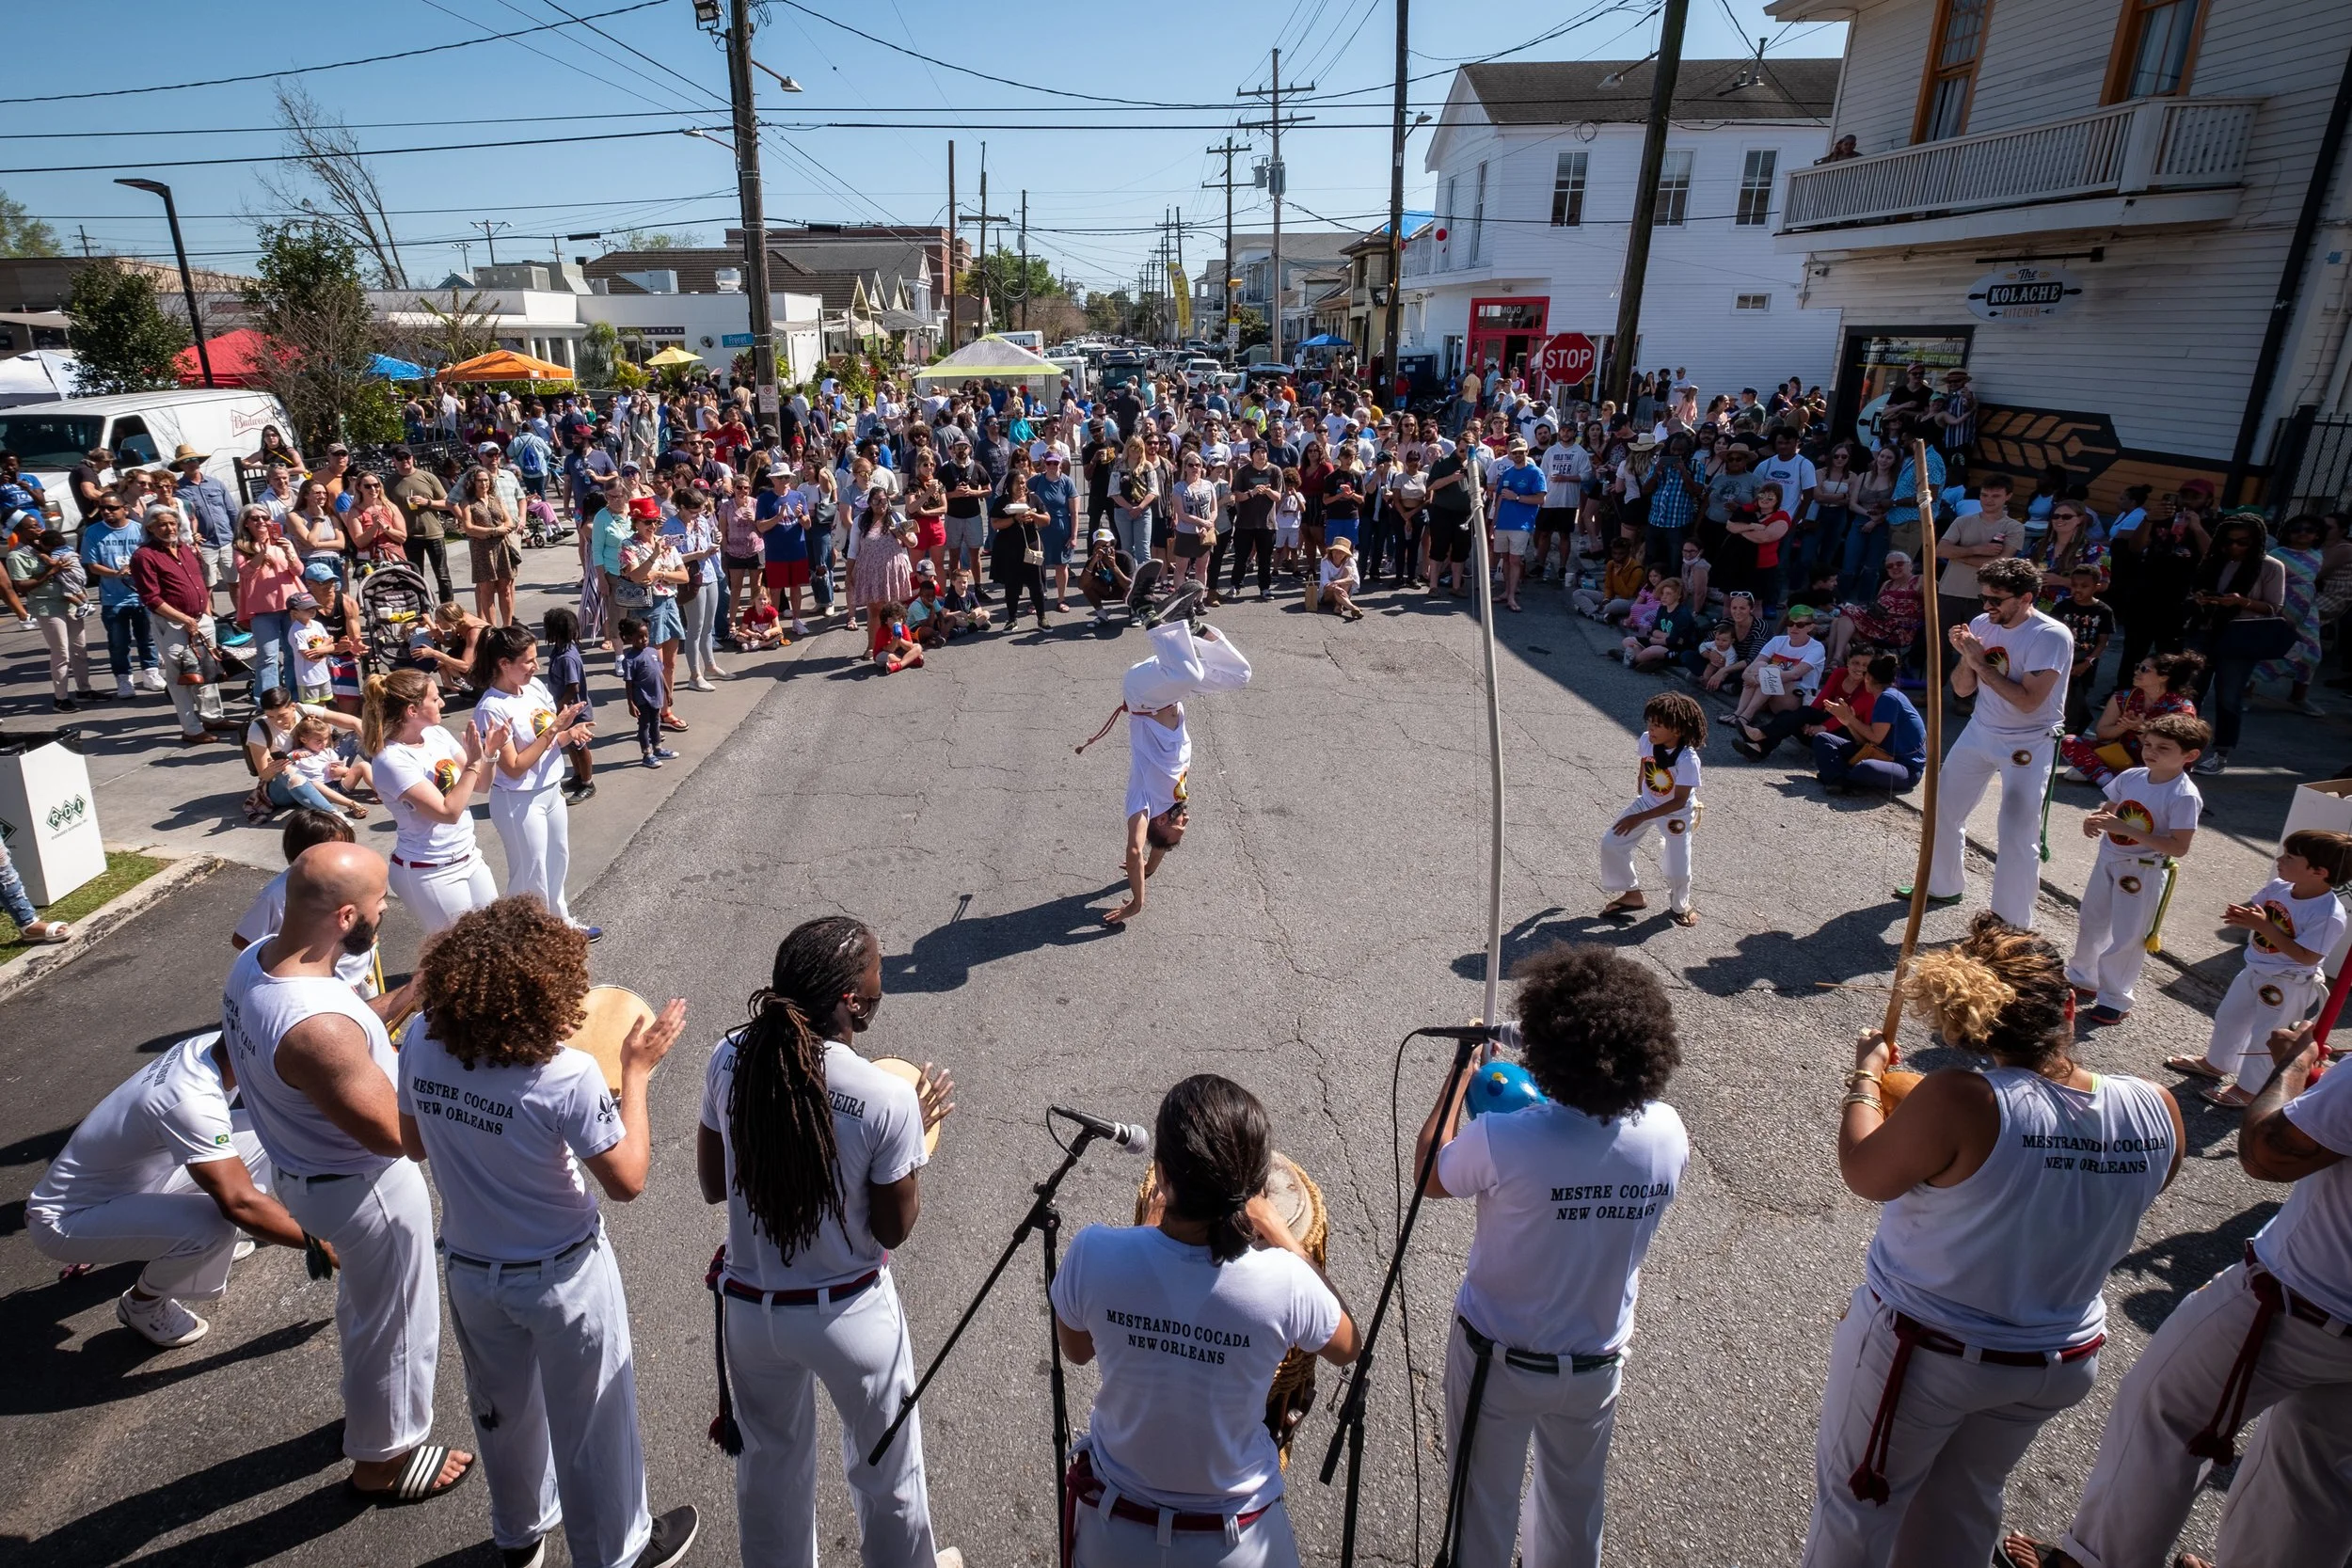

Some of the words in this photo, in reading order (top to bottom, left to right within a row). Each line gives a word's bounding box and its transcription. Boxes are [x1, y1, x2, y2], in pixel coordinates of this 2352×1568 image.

[2018, 269, 2037, 280] The
[1991, 285, 2059, 303] KOLACHE
[1501, 306, 1521, 314] MOJO
[2002, 306, 2041, 319] KITCHEN
[728, 335, 747, 344] Freret
[1545, 349, 1592, 369] STOP
[231, 414, 276, 429] Budweiser
[51, 800, 83, 824] RDI
[412, 1076, 459, 1101] MESTRE
[464, 1091, 514, 1119] COCADA
[416, 1099, 442, 1117] NEW
[446, 1106, 503, 1136] ORLEANS
[2022, 1134, 2107, 1153] MESTRANDO
[2113, 1136, 2167, 1153] COCADA
[2043, 1156, 2075, 1170] NEW
[2079, 1158, 2148, 1175] ORLEANS
[1550, 1185, 1613, 1202] MESTRE
[1619, 1182, 1670, 1199] COCADA
[1556, 1207, 1591, 1221] NEW
[1596, 1203, 1657, 1220] ORLEANS
[1106, 1308, 1191, 1338] MESTRANDO
[1194, 1326, 1251, 1348] COCADA
[1128, 1334, 1158, 1351] NEW
[1160, 1339, 1226, 1365] ORLEANS
